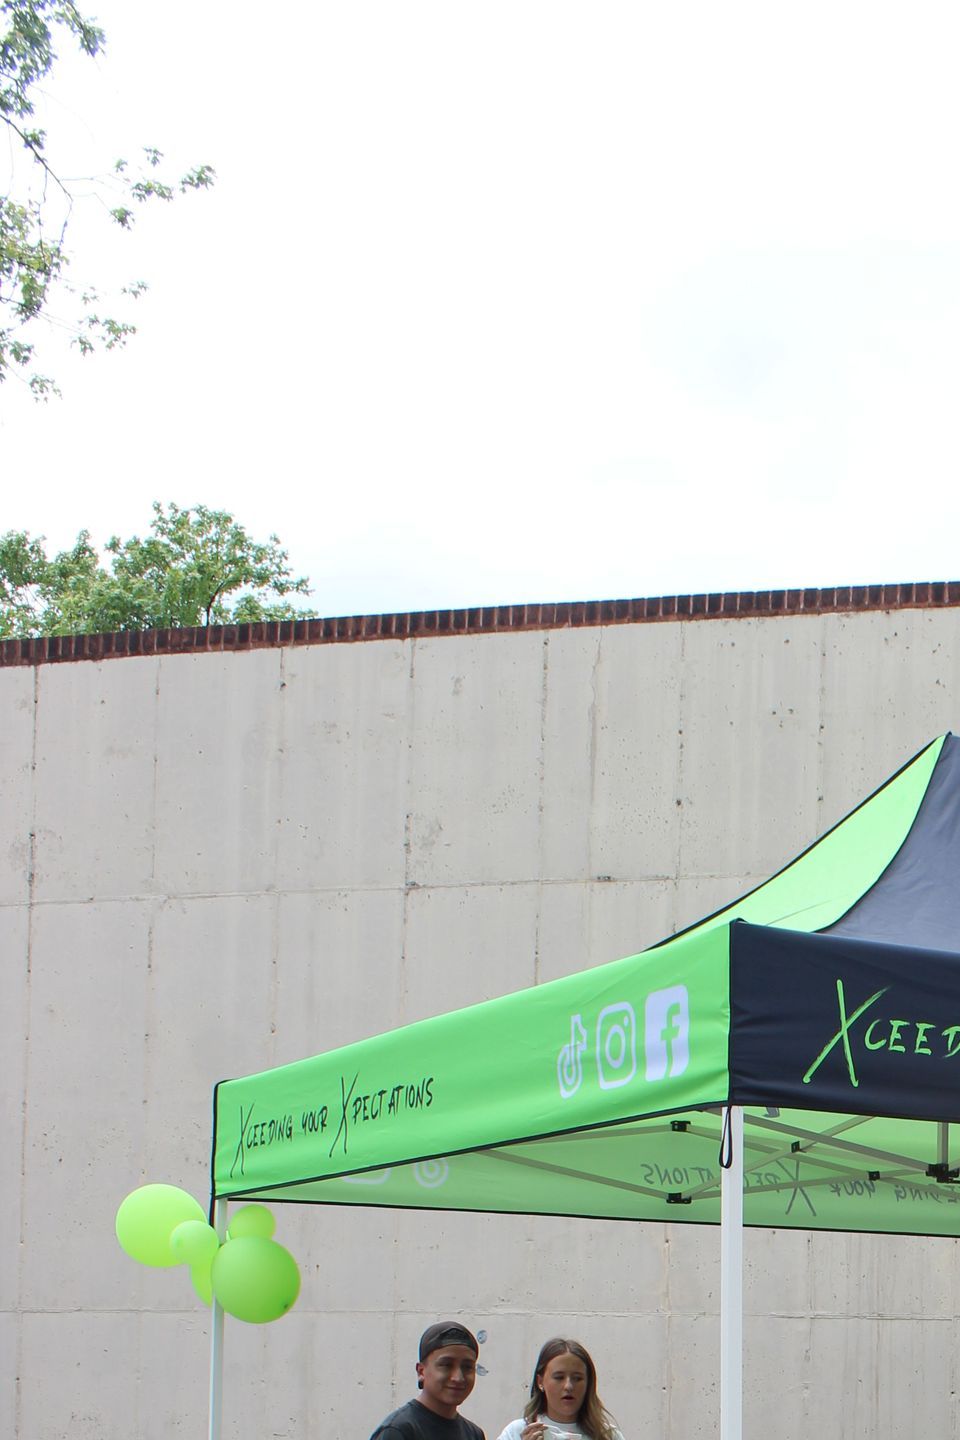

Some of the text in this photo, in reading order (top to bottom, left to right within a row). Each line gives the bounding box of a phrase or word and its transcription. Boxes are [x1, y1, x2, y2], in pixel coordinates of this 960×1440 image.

[230, 1069, 434, 1178] XCEEDING YOUR XPECTATIONS
